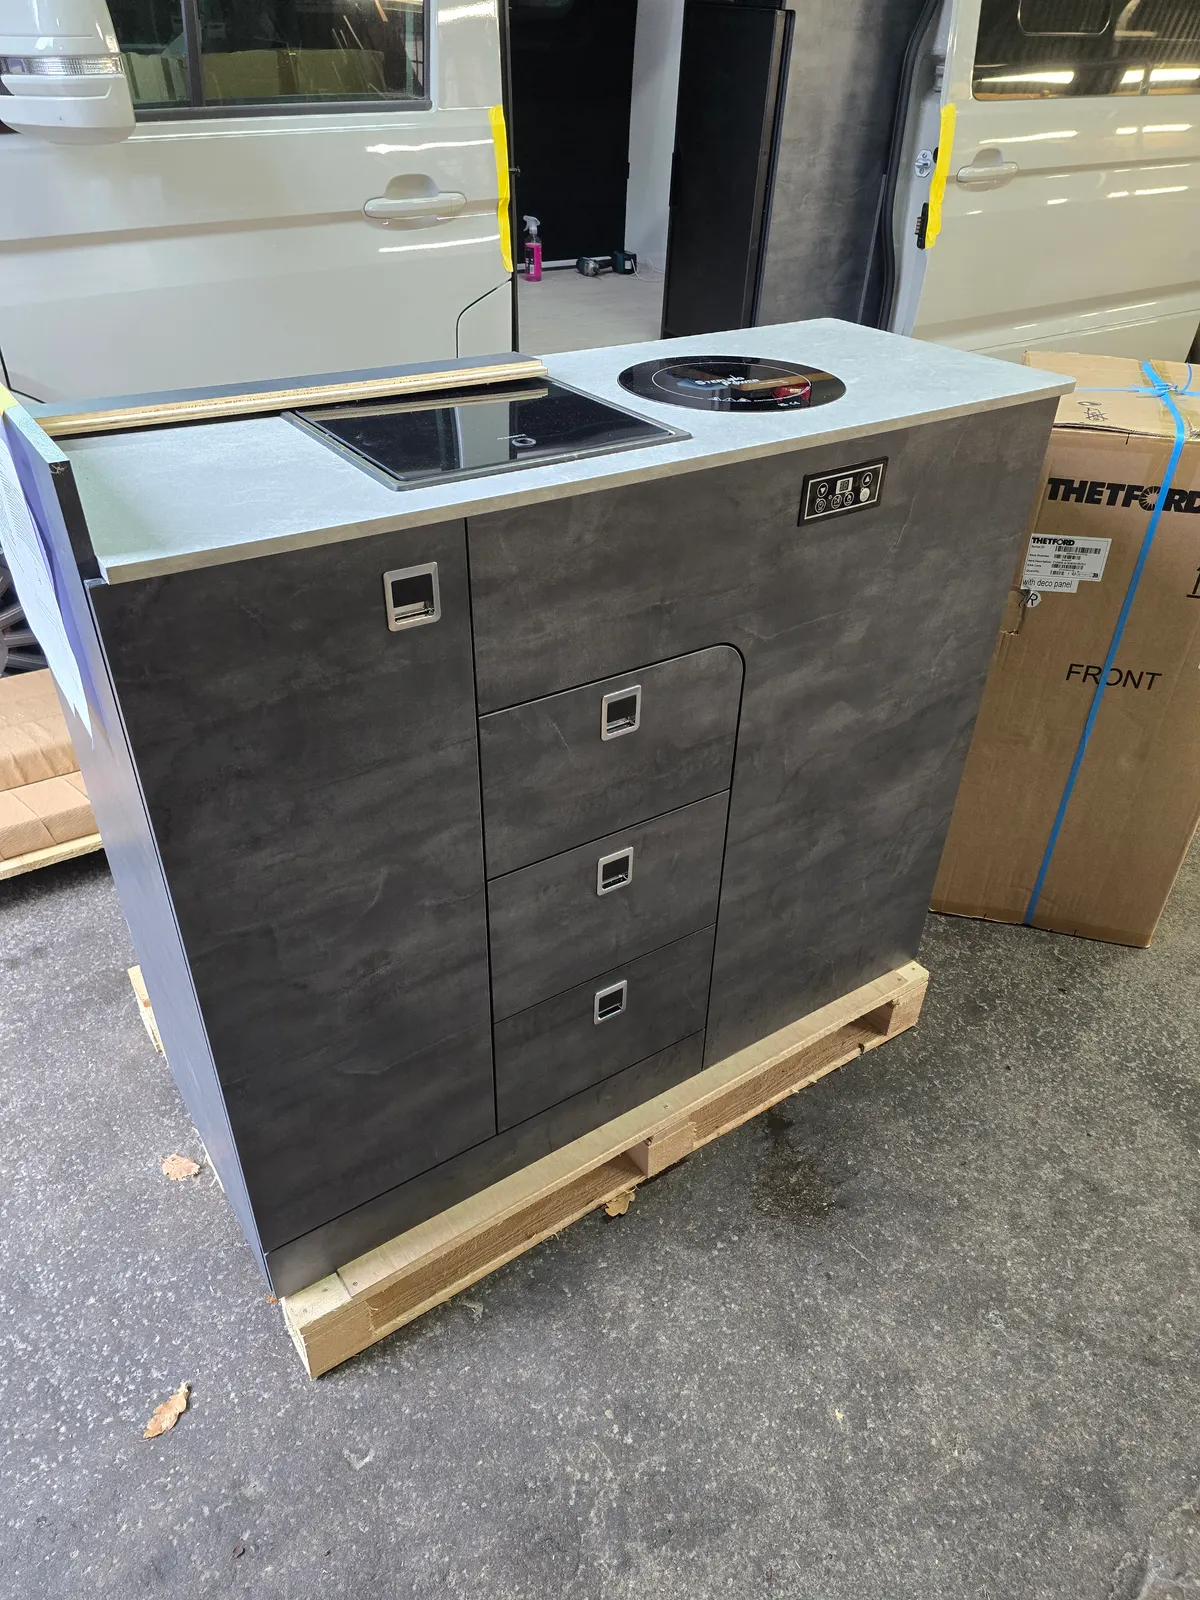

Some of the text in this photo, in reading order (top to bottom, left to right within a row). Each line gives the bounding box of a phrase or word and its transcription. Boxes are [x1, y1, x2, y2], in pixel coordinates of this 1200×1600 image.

[1031, 537, 1075, 546] THETFORD
[1022, 578, 1073, 589] with deco panel
[1065, 663, 1163, 691] FRONT
